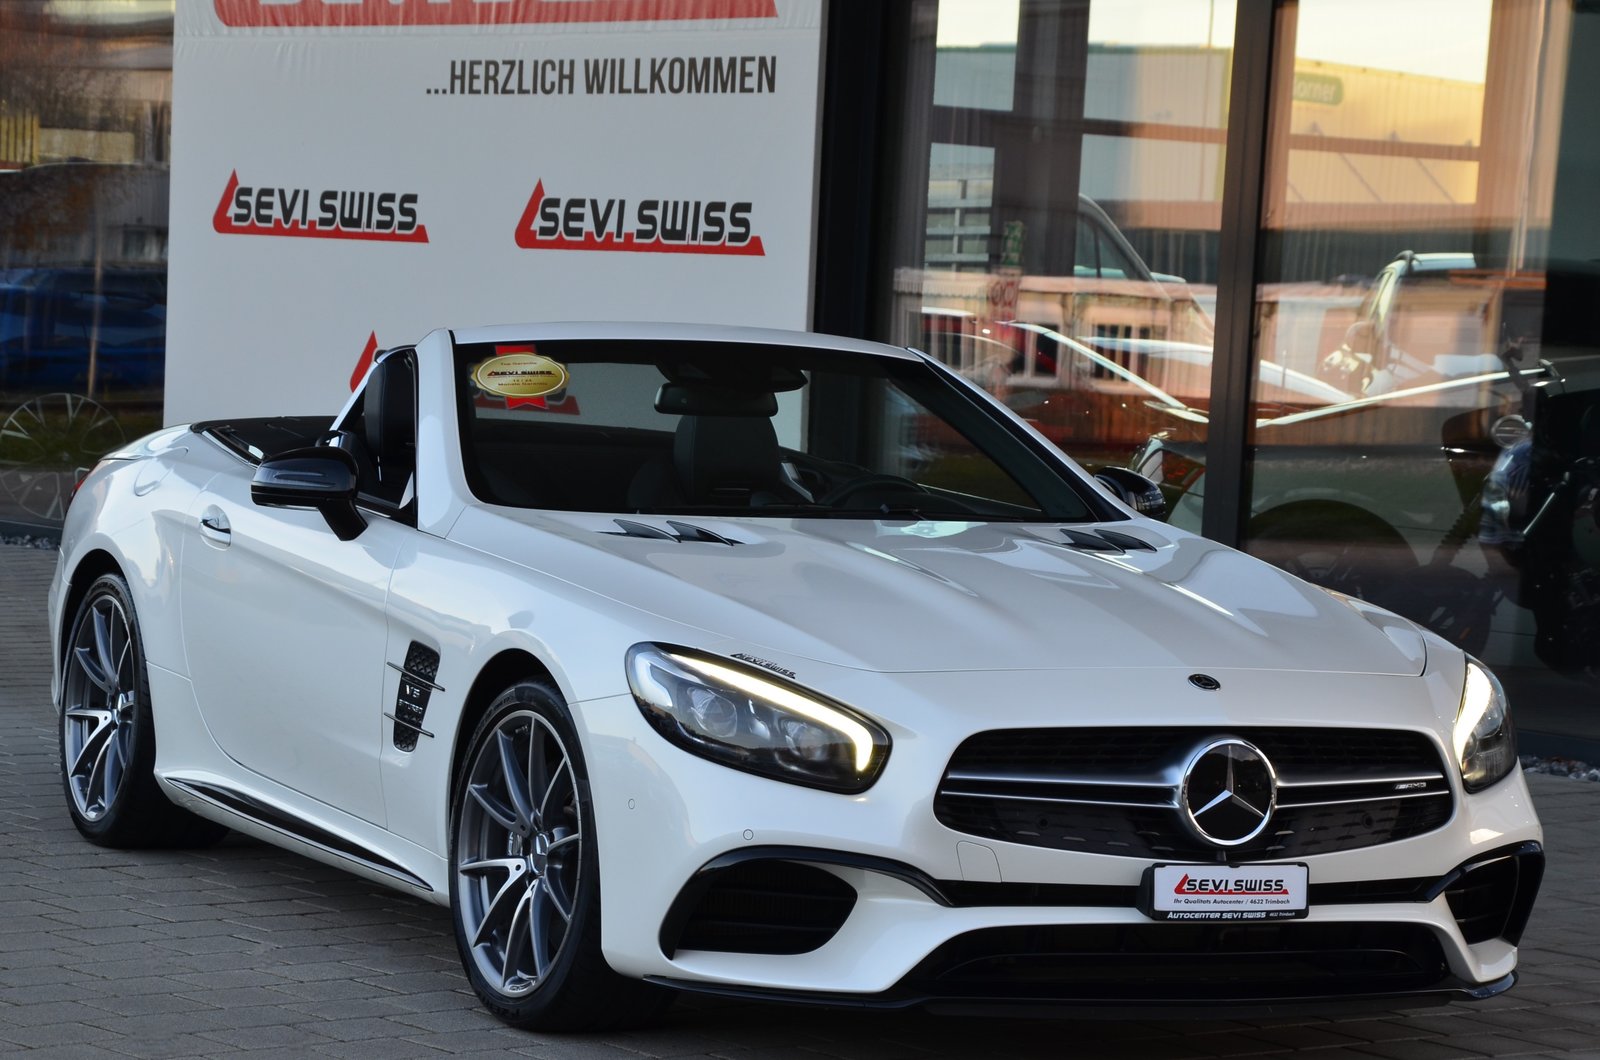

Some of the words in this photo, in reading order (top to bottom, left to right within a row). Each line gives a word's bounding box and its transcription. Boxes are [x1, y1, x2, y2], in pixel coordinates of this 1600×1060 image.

[584, 55, 777, 95] WILLKOMMEN
[233, 186, 310, 227] SEVI
[317, 189, 419, 232] SWISS
[539, 197, 626, 240] SEVI
[635, 199, 753, 244] SWISS
[1185, 878, 1229, 892] SEVI
[1233, 879, 1284, 892] SWISS
[1242, 911, 1267, 919] SWISS
